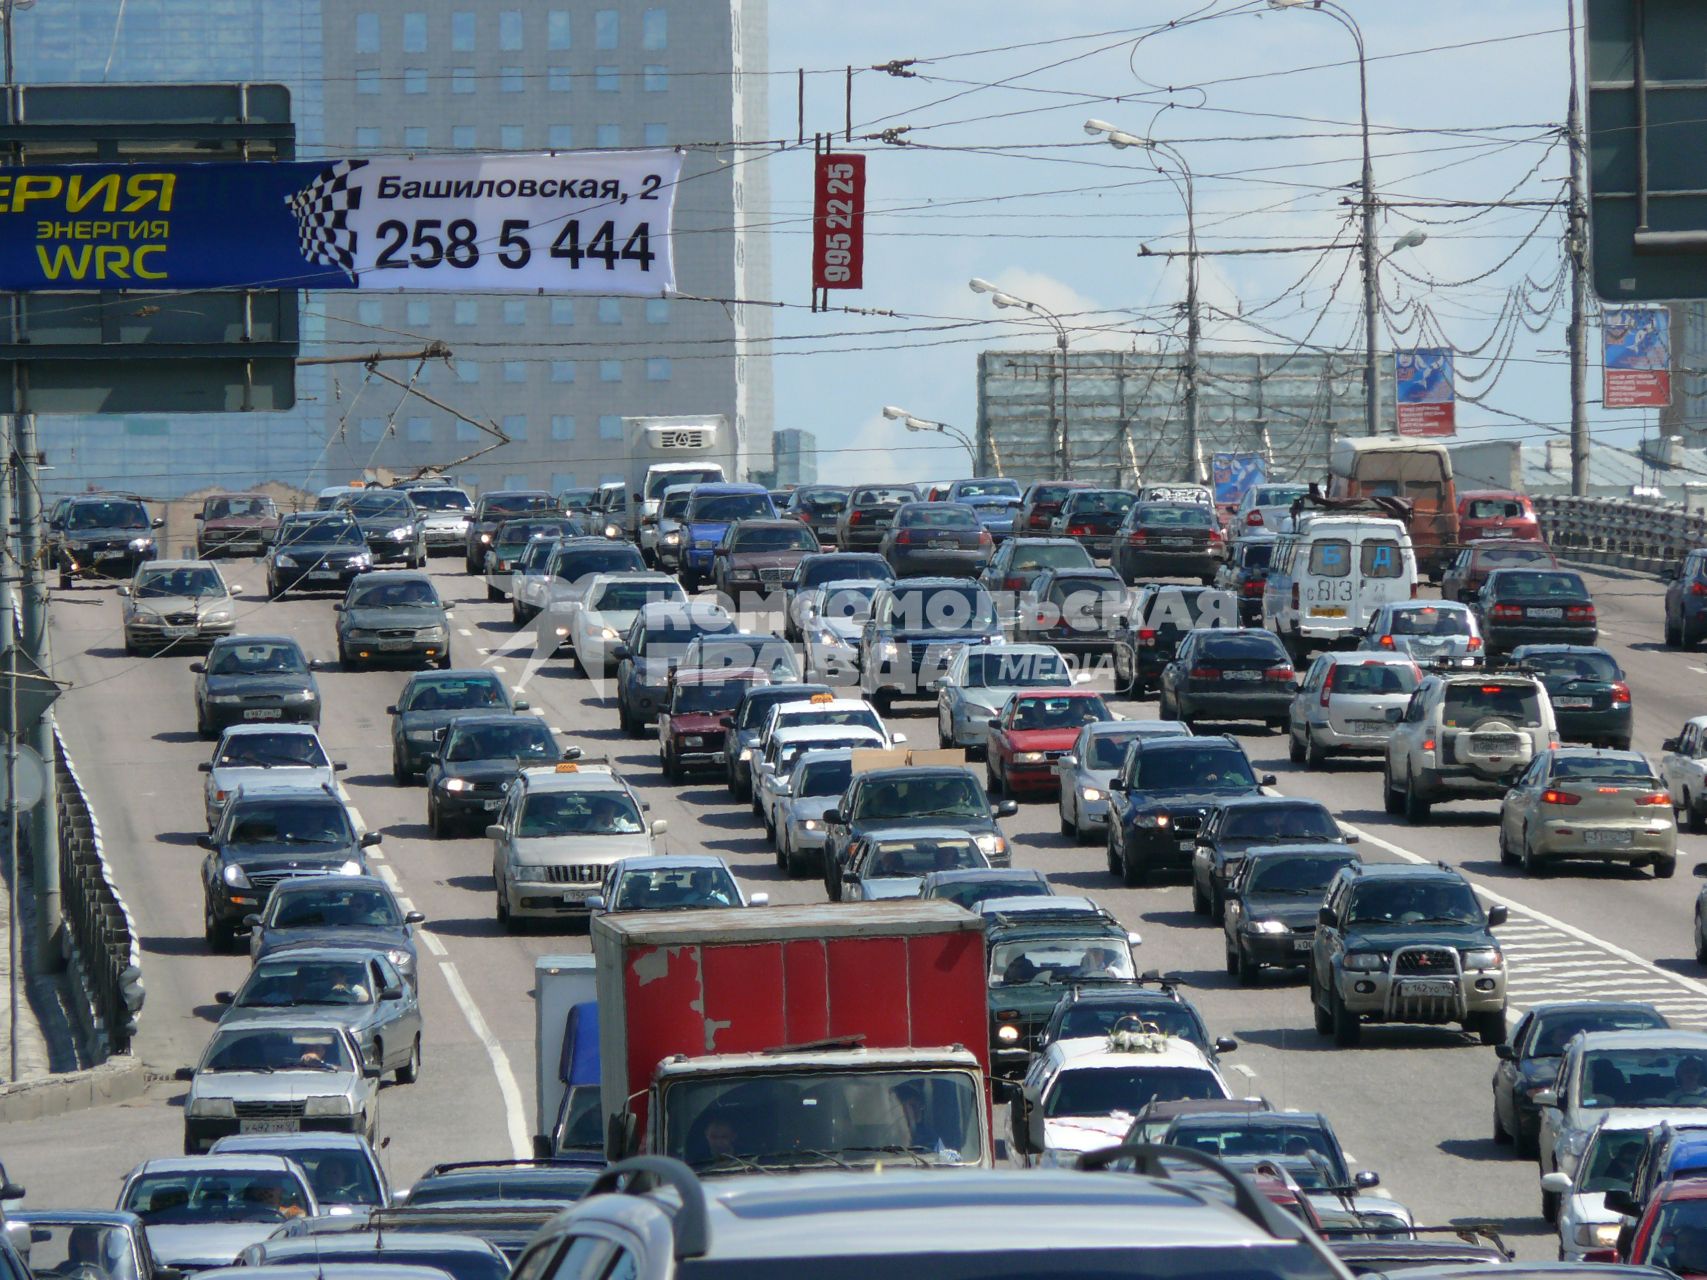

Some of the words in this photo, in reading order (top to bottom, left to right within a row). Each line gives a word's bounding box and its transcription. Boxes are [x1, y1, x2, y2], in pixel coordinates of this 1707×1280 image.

[0, 173, 176, 213] РИЯ
[377, 175, 628, 205] Башиловская,
[639, 174, 662, 201] 2
[826, 163, 854, 194] 25
[36, 220, 169, 239] ЭНЕРГИЯ
[826, 199, 853, 229] 22
[375, 218, 480, 270] 258
[498, 219, 531, 270] 5
[550, 219, 655, 272] 444
[824, 233, 851, 282] 995
[36, 245, 168, 280] WRC
[1323, 544, 1341, 566] Б
[1371, 545, 1392, 572] Д
